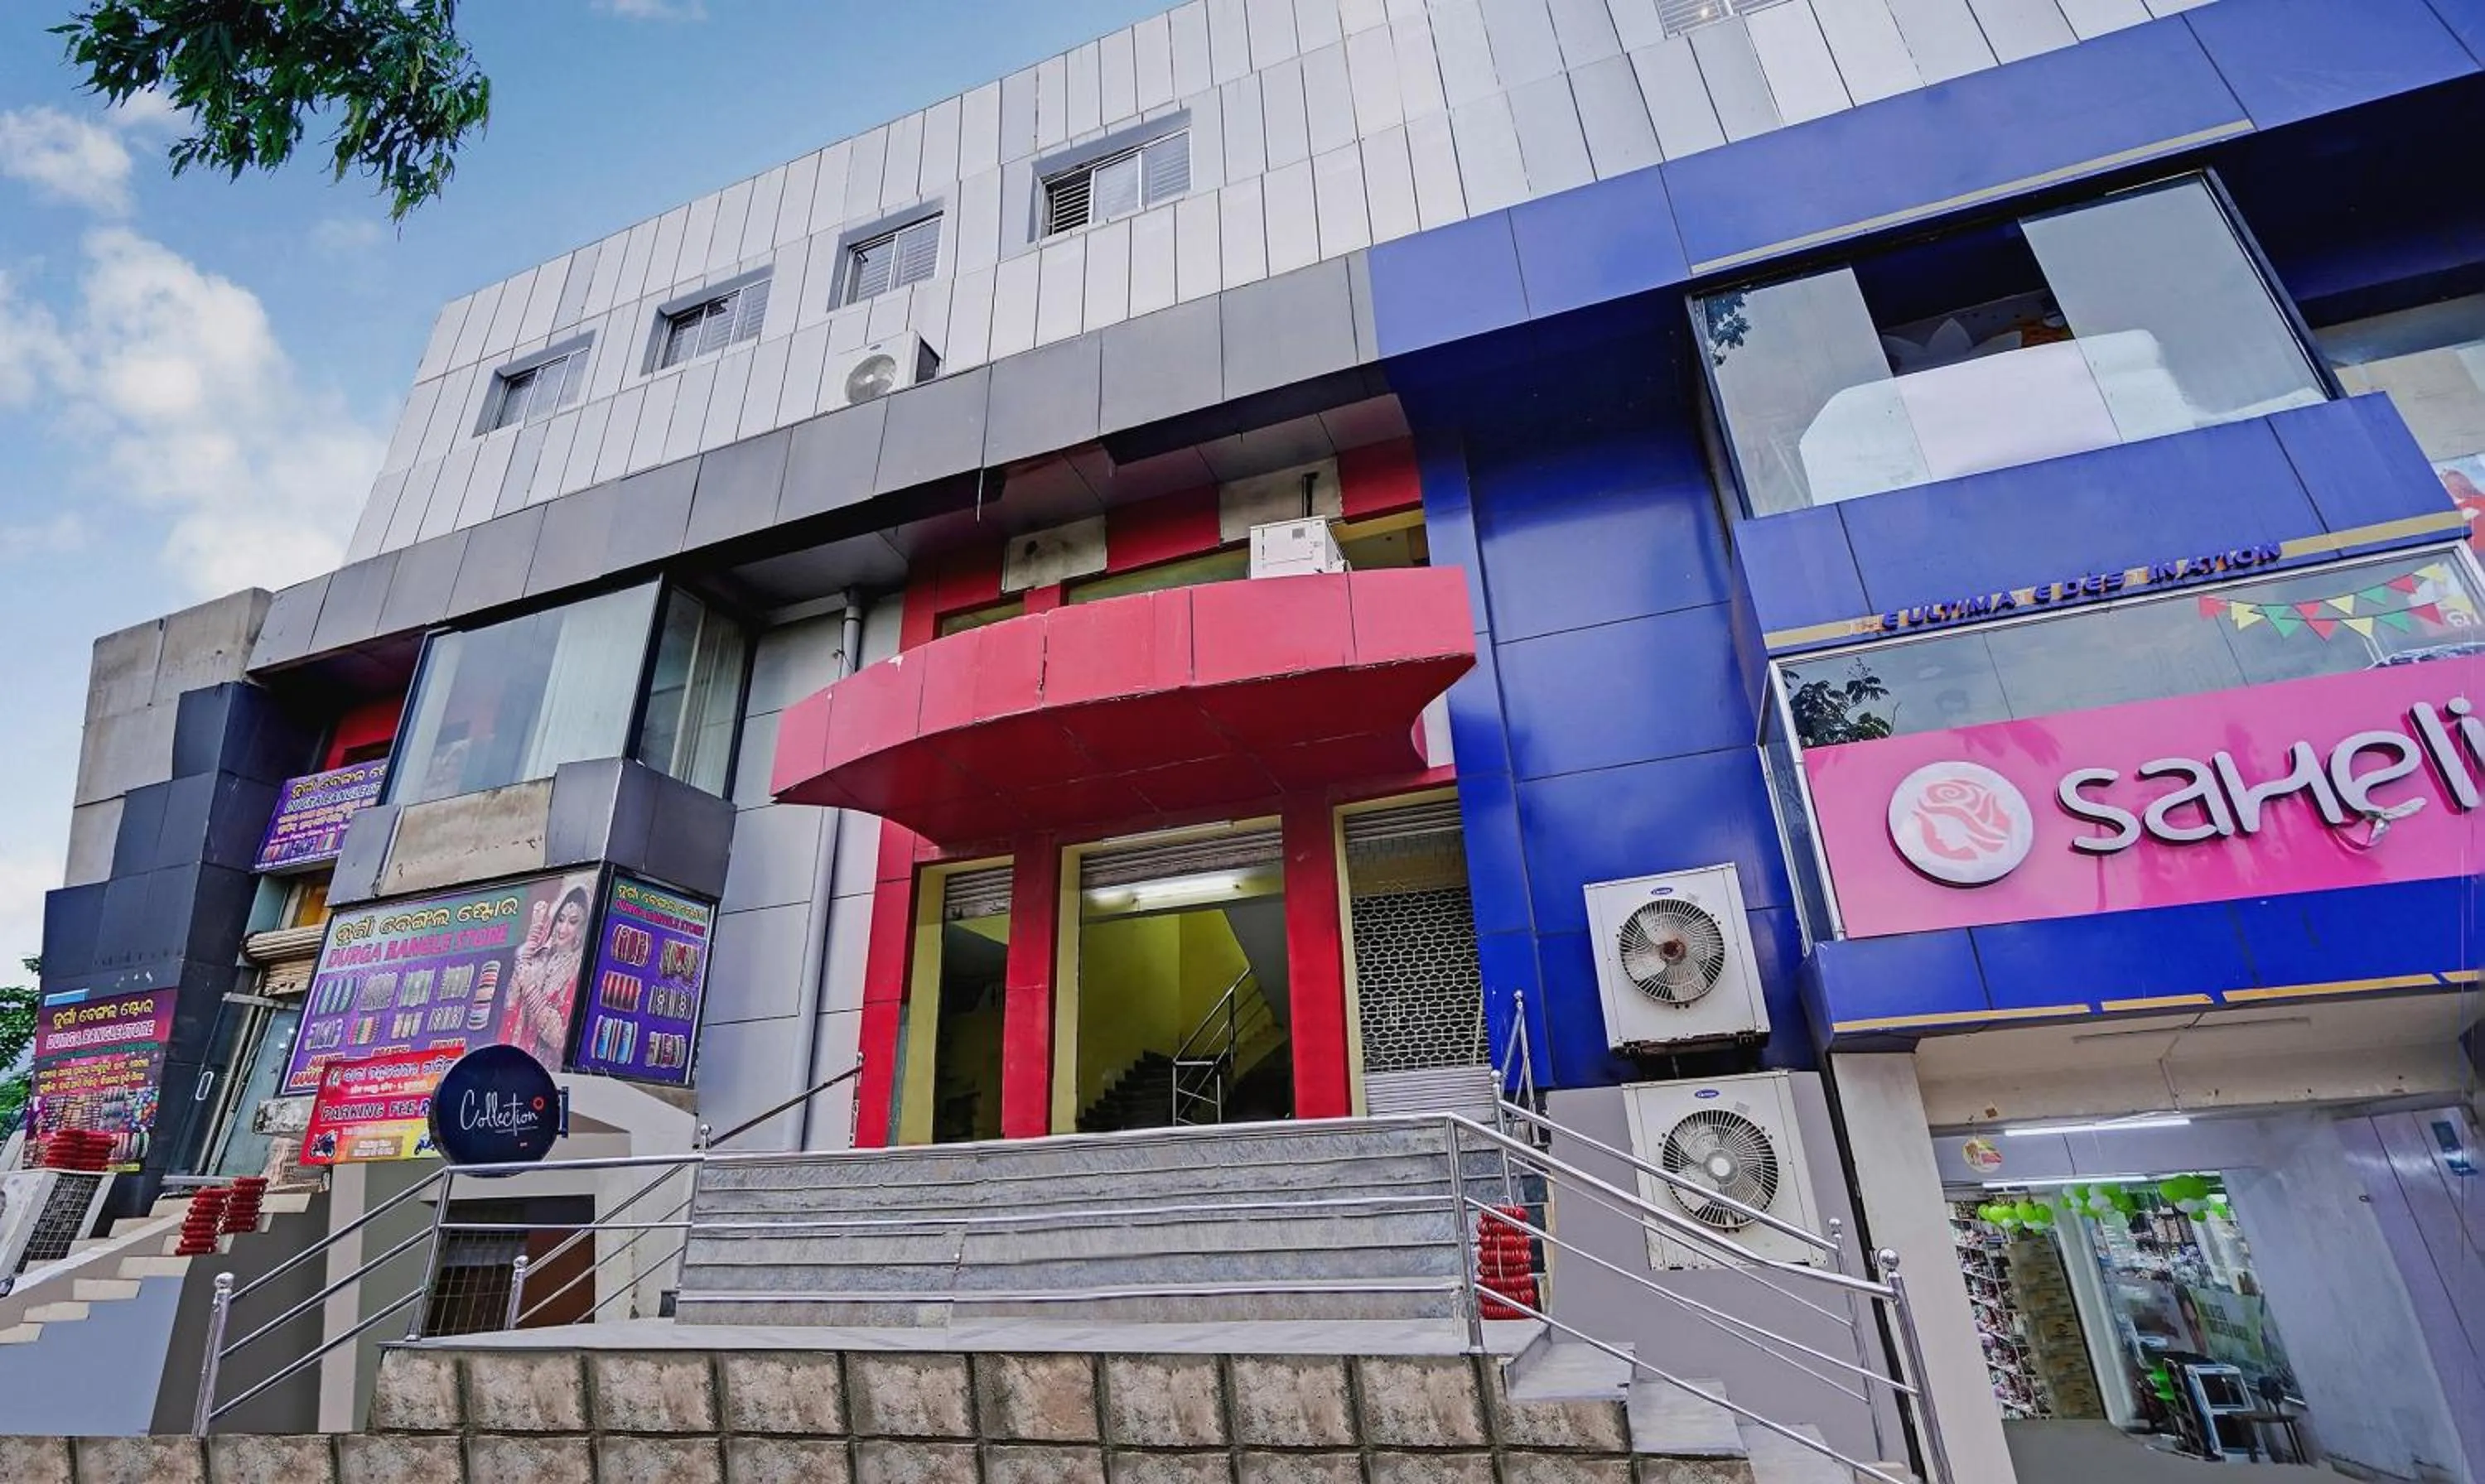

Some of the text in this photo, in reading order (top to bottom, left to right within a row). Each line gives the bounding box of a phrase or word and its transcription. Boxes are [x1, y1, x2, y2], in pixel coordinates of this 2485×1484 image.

[327, 944, 380, 967] DURGA
[321, 1102, 385, 1120] PARKING
[460, 1089, 538, 1137] Collection
